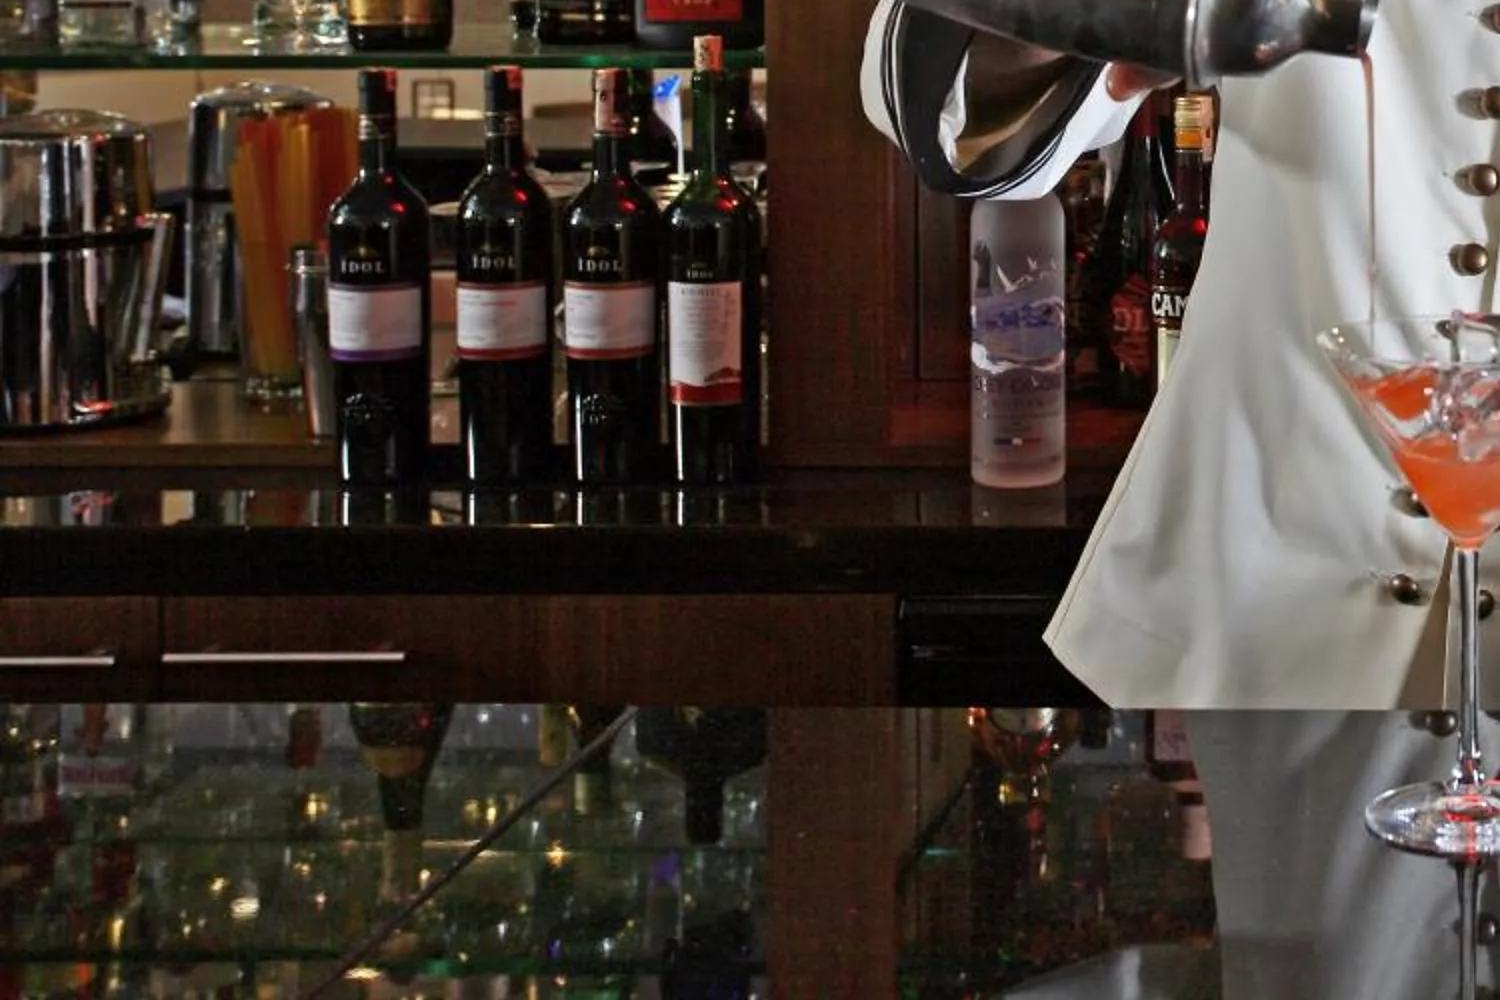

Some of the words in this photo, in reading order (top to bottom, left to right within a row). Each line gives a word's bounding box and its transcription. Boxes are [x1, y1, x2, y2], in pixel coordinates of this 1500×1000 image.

[340, 259, 387, 274] IDOL
[472, 253, 518, 270] IDOL
[577, 256, 625, 273] IDOL
[1151, 291, 1189, 317] CAM
